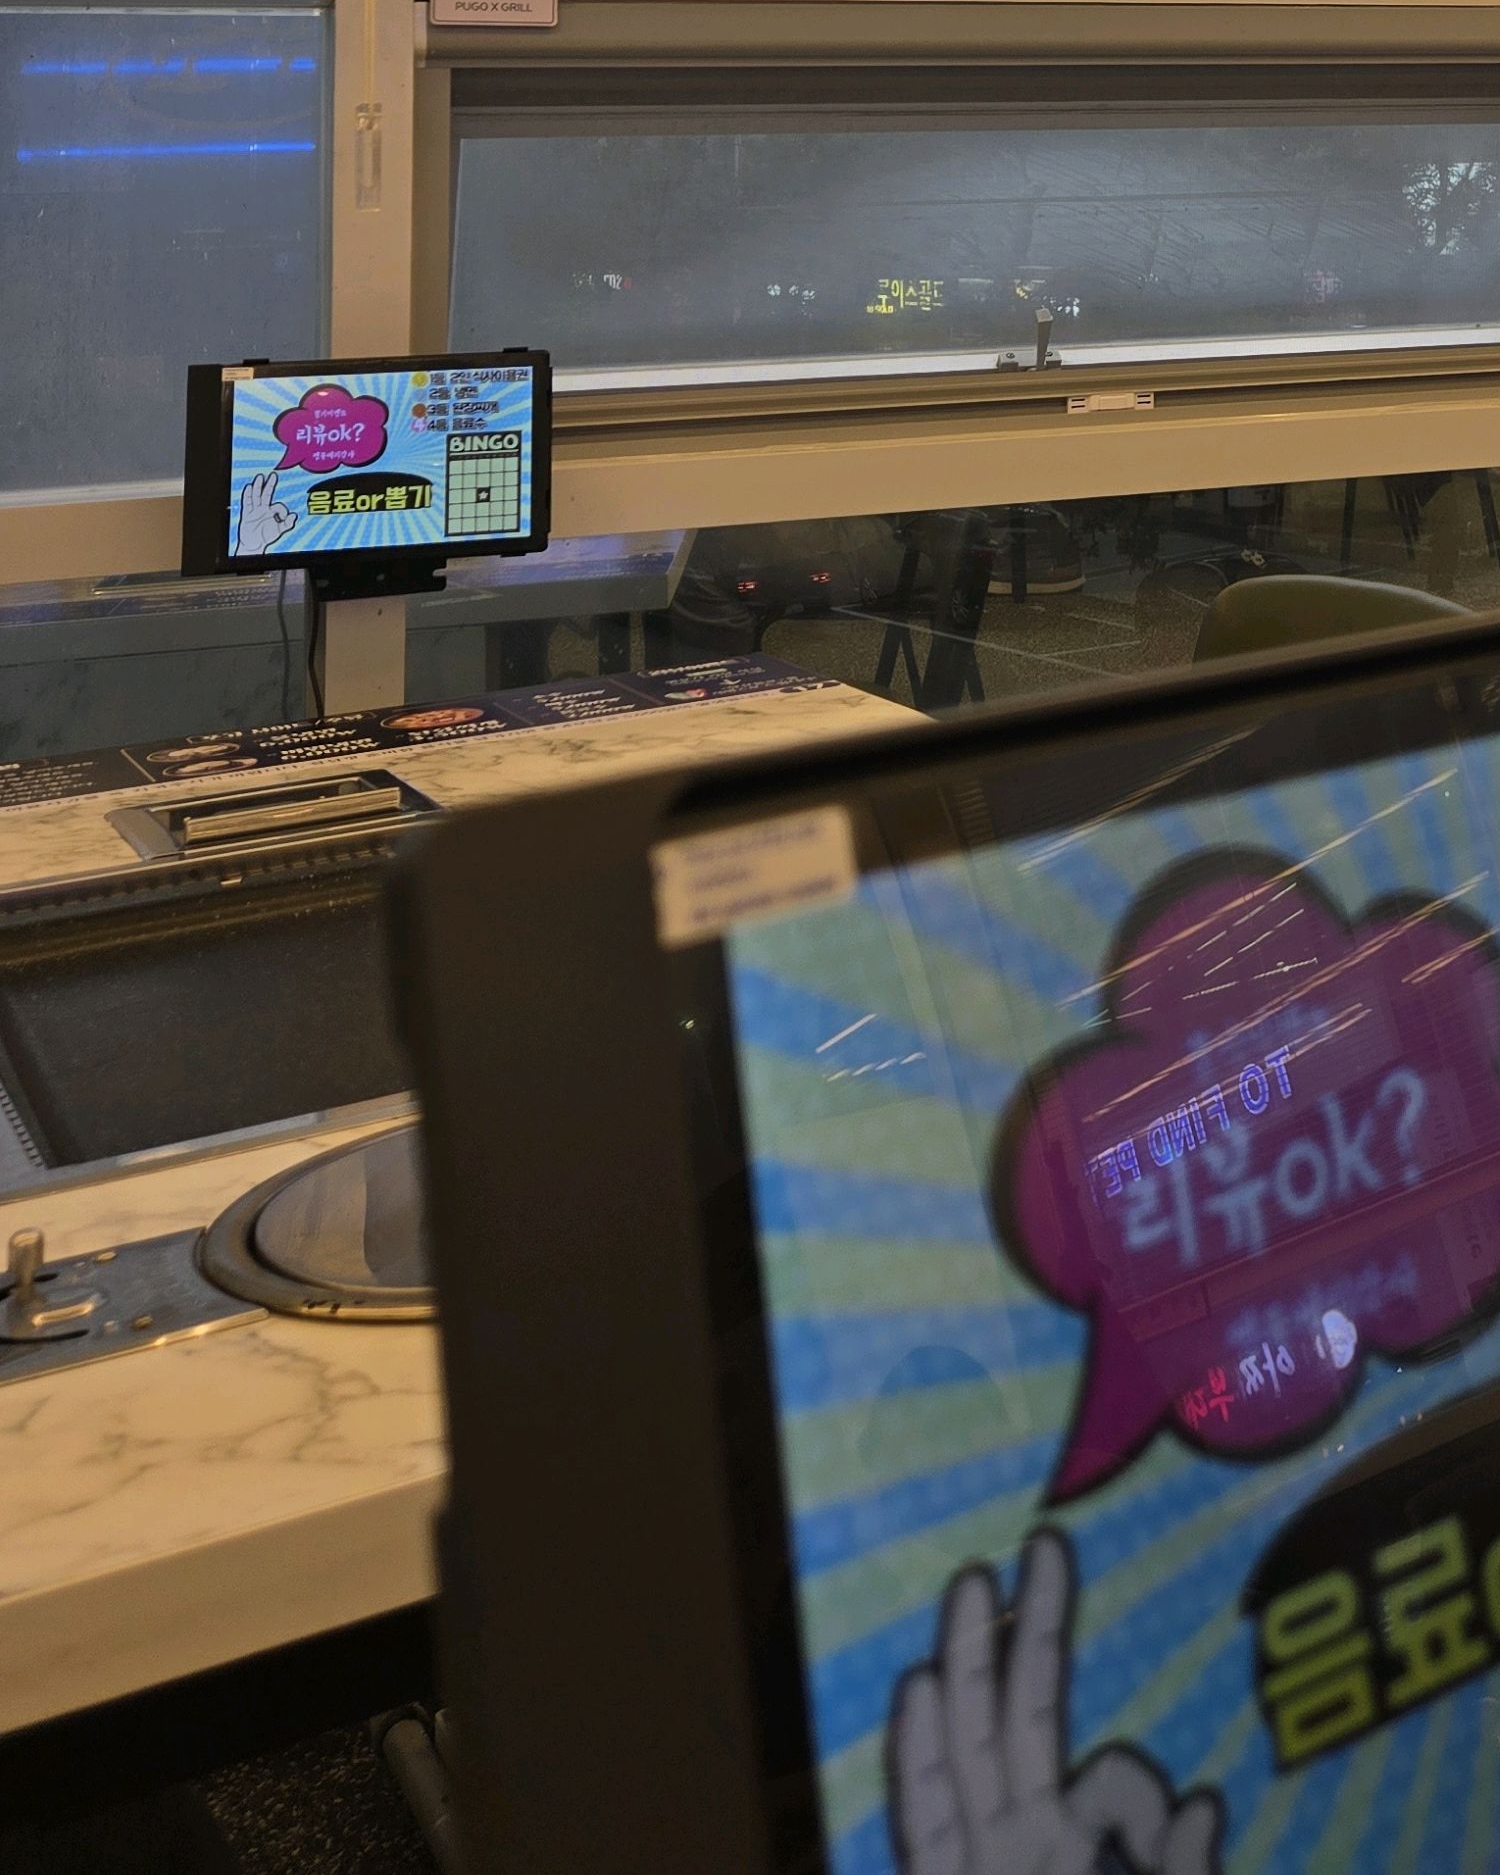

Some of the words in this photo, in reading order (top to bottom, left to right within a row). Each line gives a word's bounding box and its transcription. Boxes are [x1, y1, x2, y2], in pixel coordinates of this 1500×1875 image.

[455, 1, 488, 13] PUGO
[491, 2, 498, 12] X
[501, 2, 533, 14] GRILL
[296, 422, 365, 446] 리뷰ok?
[449, 434, 520, 452] BINGO
[306, 484, 433, 515] 음료or뽑기
[1118, 1067, 1431, 1272] 리뷰ok?
